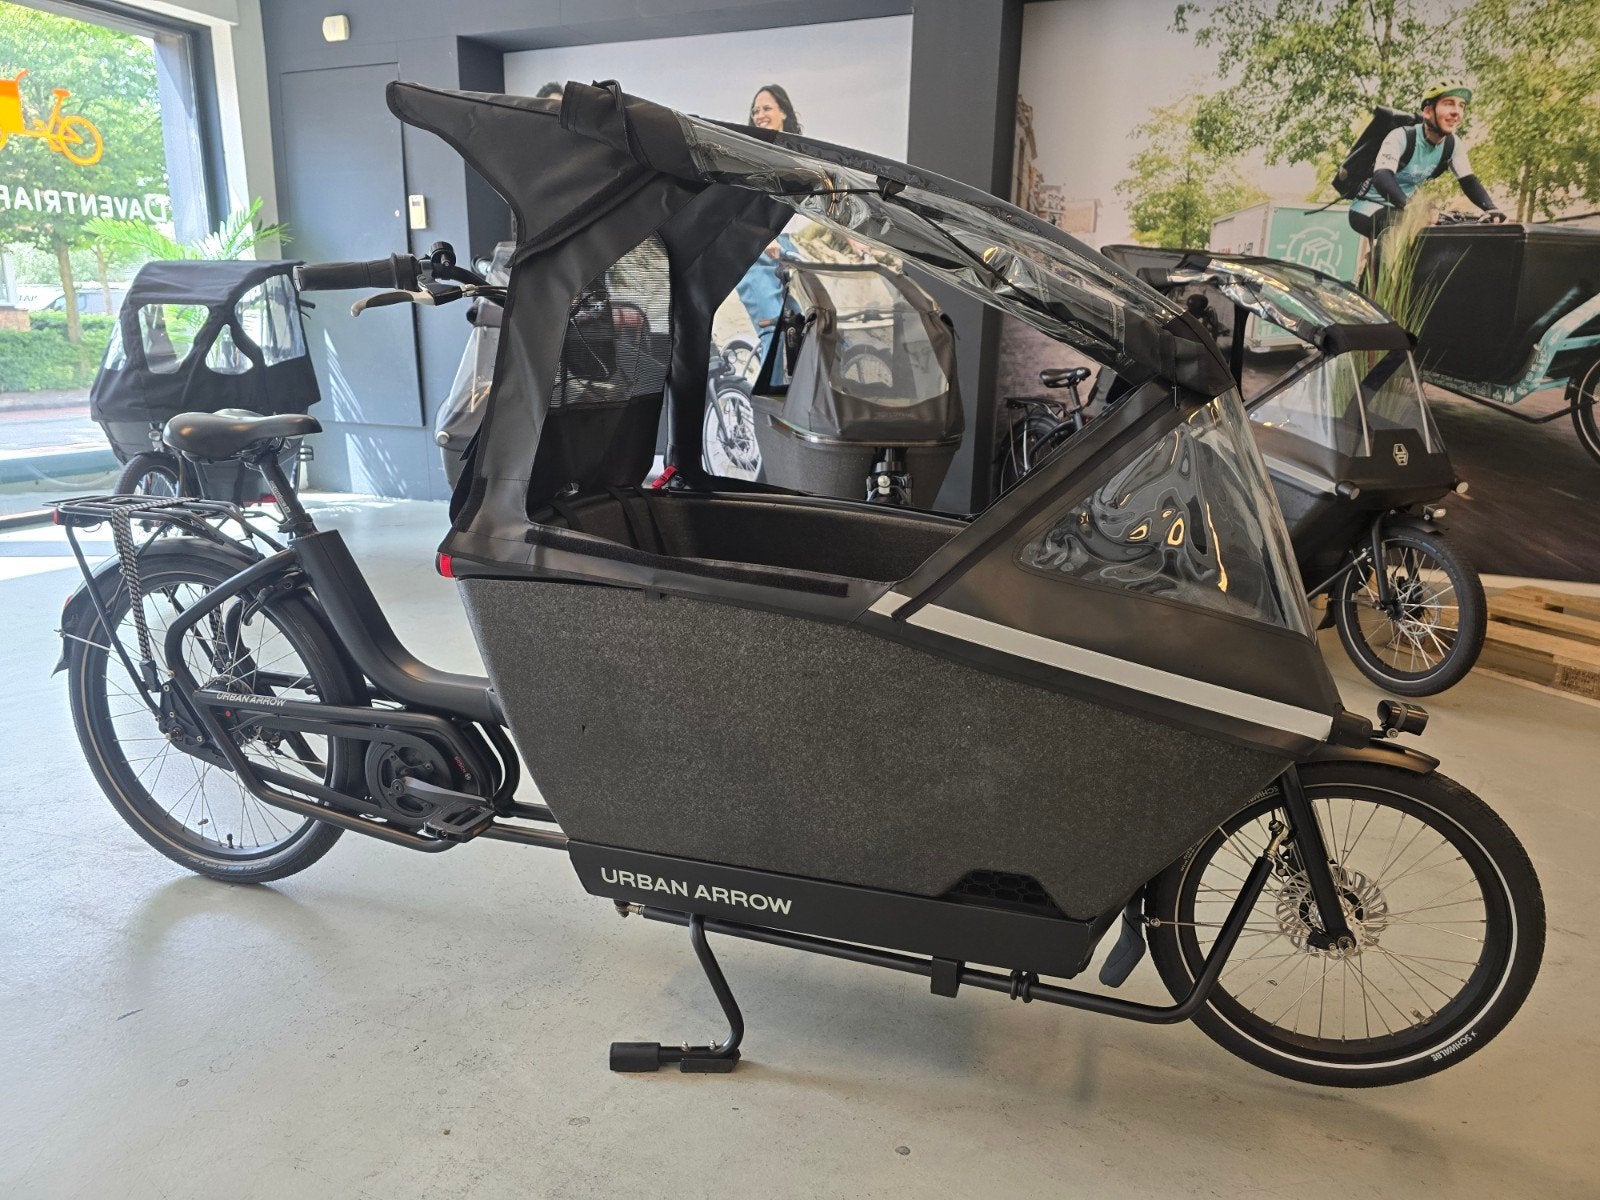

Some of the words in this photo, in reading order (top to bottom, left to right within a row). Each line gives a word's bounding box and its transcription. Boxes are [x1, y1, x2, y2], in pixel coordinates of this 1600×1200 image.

[216, 692, 250, 703] URBAN
[249, 696, 287, 707] ARROW
[600, 866, 689, 898] URBAN
[694, 884, 793, 915] ARROW
[1430, 1034, 1473, 1062] SCHWALBE
